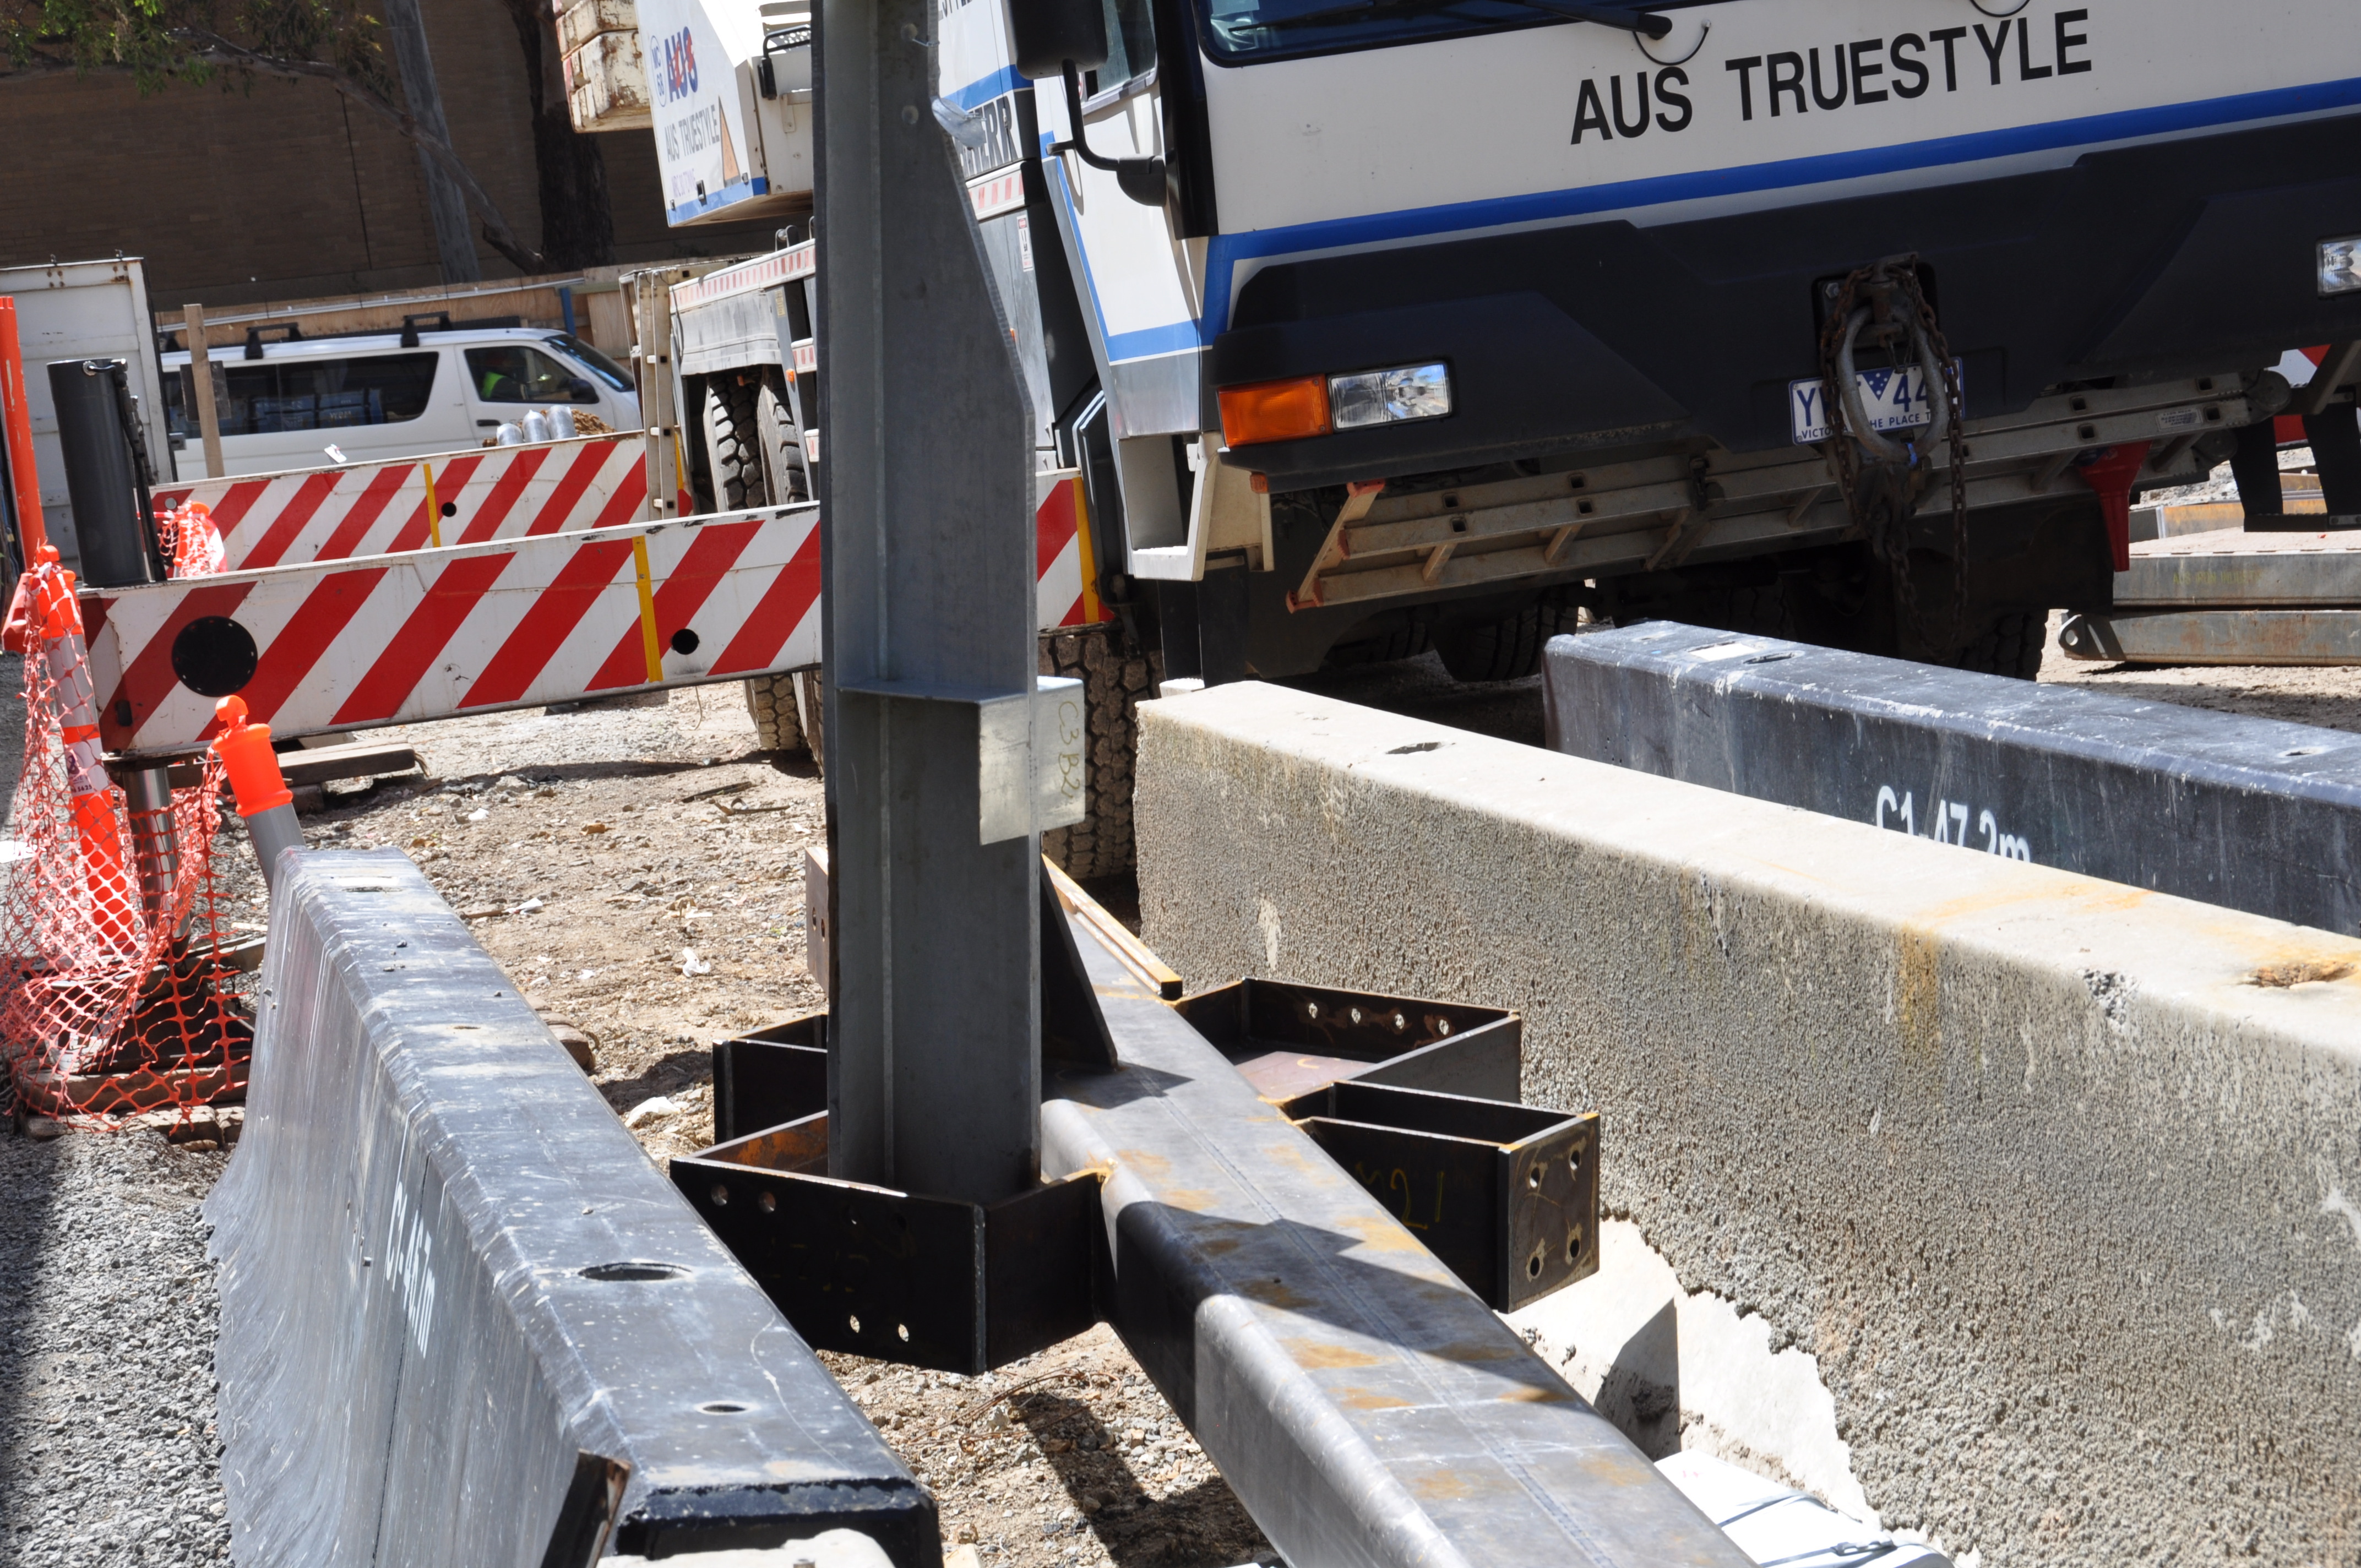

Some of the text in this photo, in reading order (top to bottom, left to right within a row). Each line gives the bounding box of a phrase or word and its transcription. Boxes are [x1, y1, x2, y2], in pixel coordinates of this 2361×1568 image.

[664, 26, 698, 103] AUS
[1571, 8, 2092, 145] AUS TRUESTYLE
[664, 104, 720, 163] AUS TRUESTYLE
[1870, 418, 1883, 428] HE
[1889, 413, 1920, 426] PLACE
